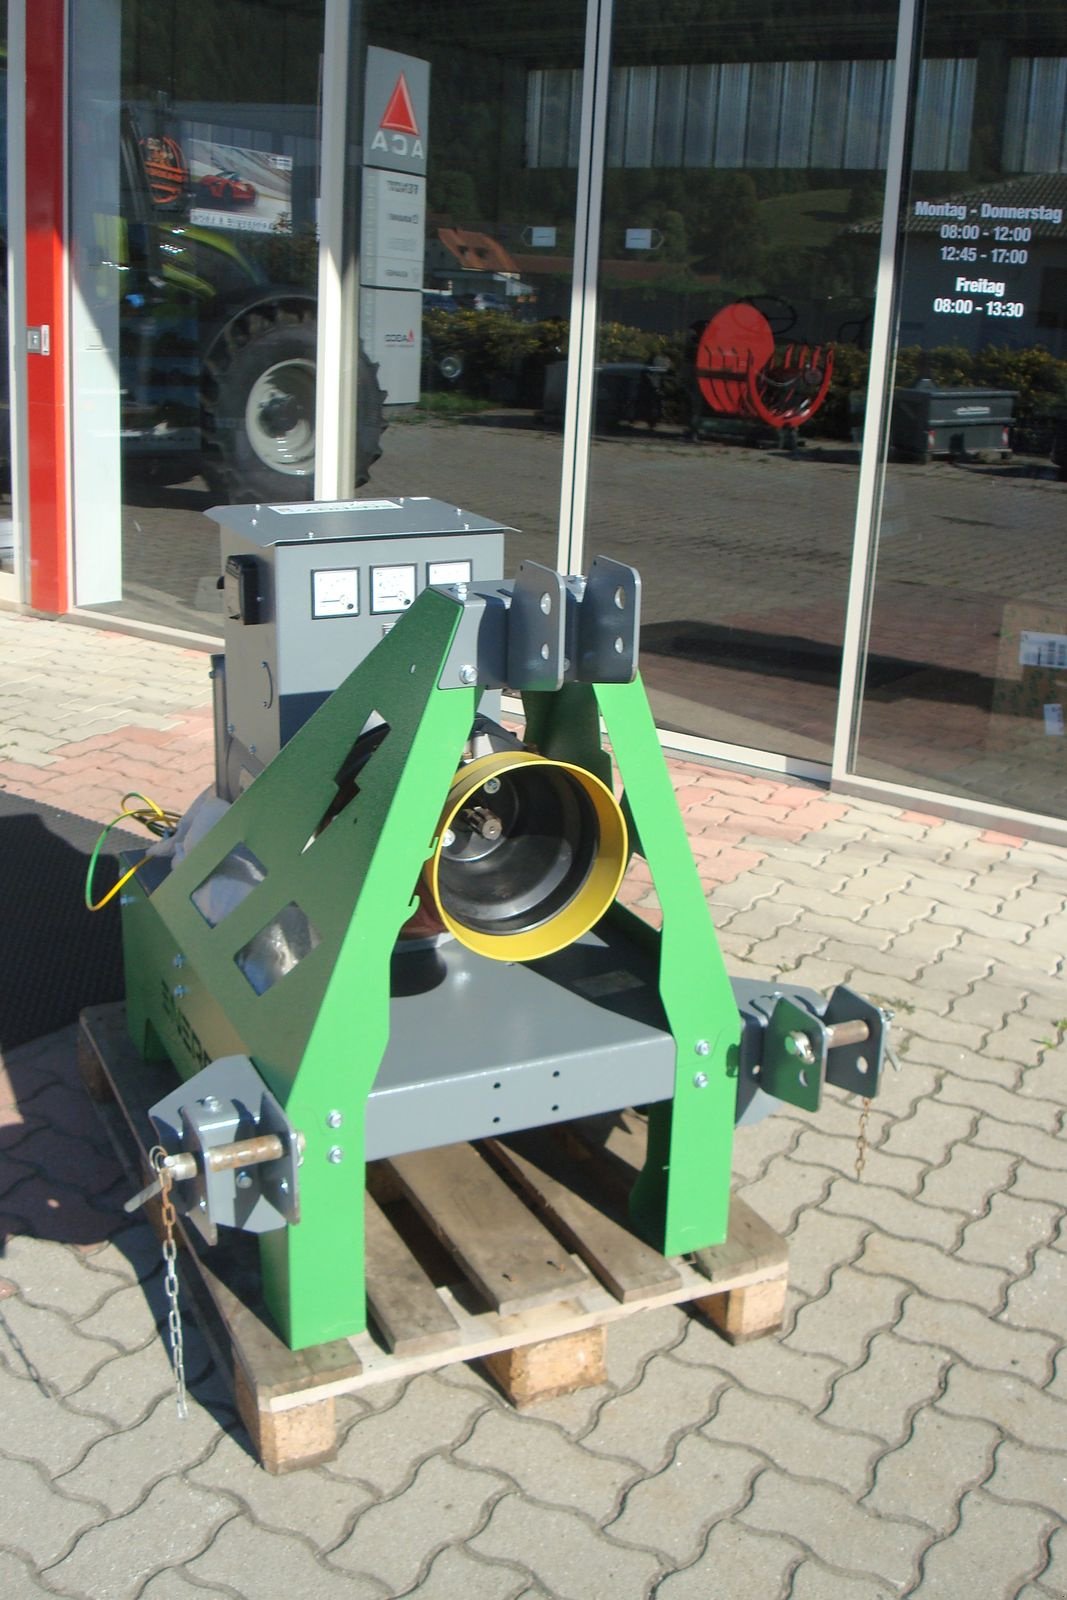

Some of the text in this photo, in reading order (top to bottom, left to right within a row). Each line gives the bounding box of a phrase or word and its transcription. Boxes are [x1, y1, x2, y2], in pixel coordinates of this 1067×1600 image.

[914, 201, 967, 220] Montag
[980, 203, 1063, 223] Donnerstag
[940, 224, 980, 240] 08:00
[993, 226, 1032, 242] 12:00
[940, 246, 977, 262] 12:45
[991, 248, 1028, 264] 17:00
[955, 276, 1006, 297] Freitag
[933, 297, 973, 314] 08:00
[985, 300, 1024, 318] 13:30
